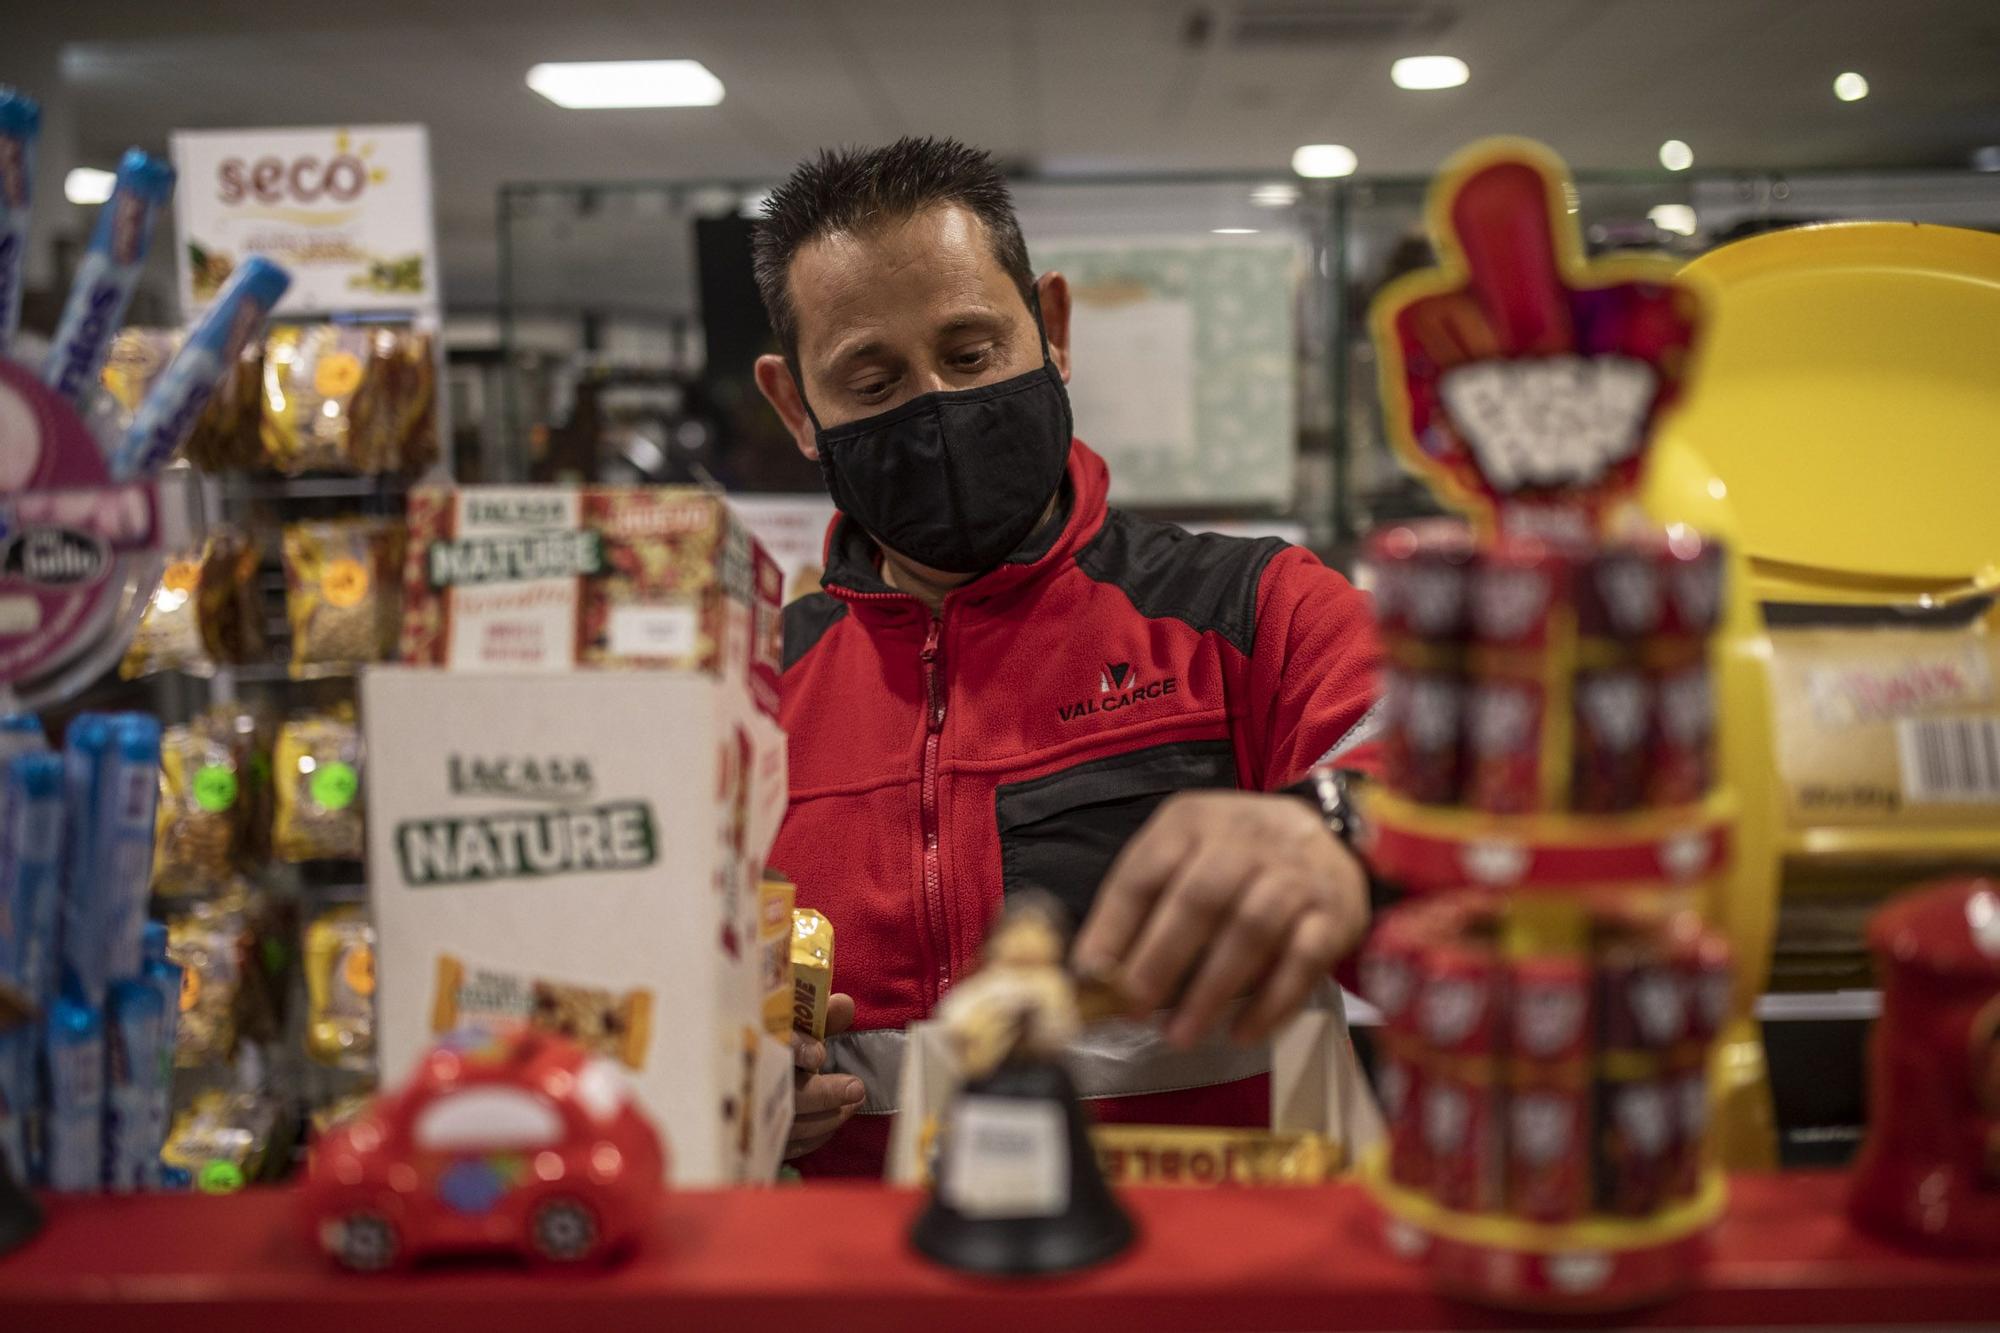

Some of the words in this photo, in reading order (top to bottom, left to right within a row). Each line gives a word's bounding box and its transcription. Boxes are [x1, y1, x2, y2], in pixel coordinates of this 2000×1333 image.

[431, 531, 598, 586] NATURE
[1058, 677, 1176, 721] VALCARCE
[404, 804, 646, 880] NATURE
